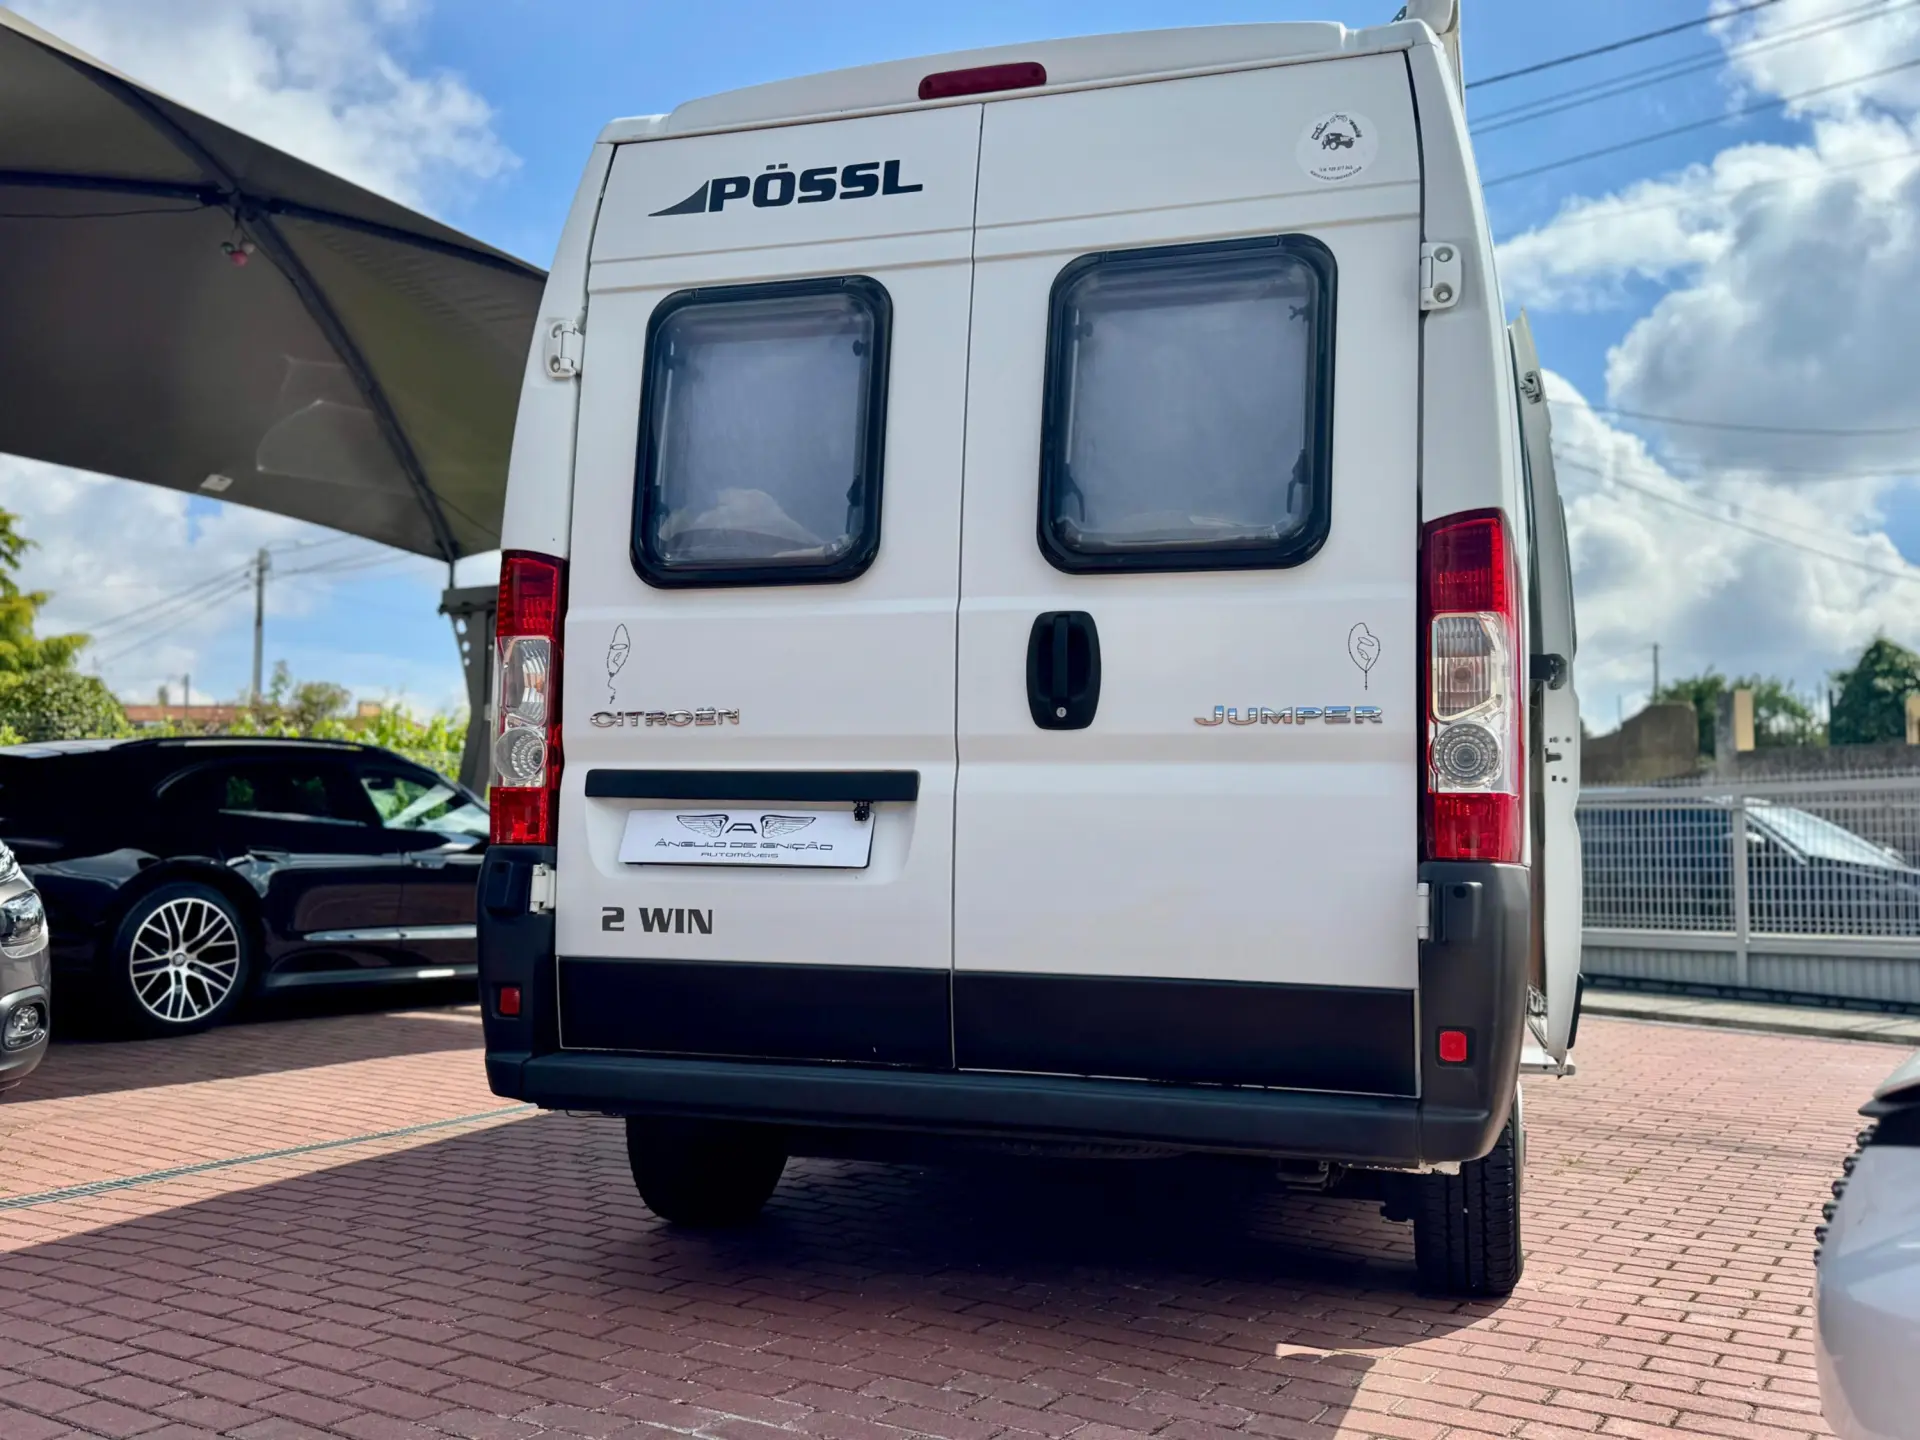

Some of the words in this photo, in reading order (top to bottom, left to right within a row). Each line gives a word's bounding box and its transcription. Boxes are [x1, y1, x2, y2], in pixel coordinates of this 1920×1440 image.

[708, 159, 923, 212] PÖSSL
[590, 707, 740, 727] CITROËN
[1194, 705, 1383, 726] JUMPER
[601, 906, 625, 932] 2
[639, 907, 713, 934] WIN
